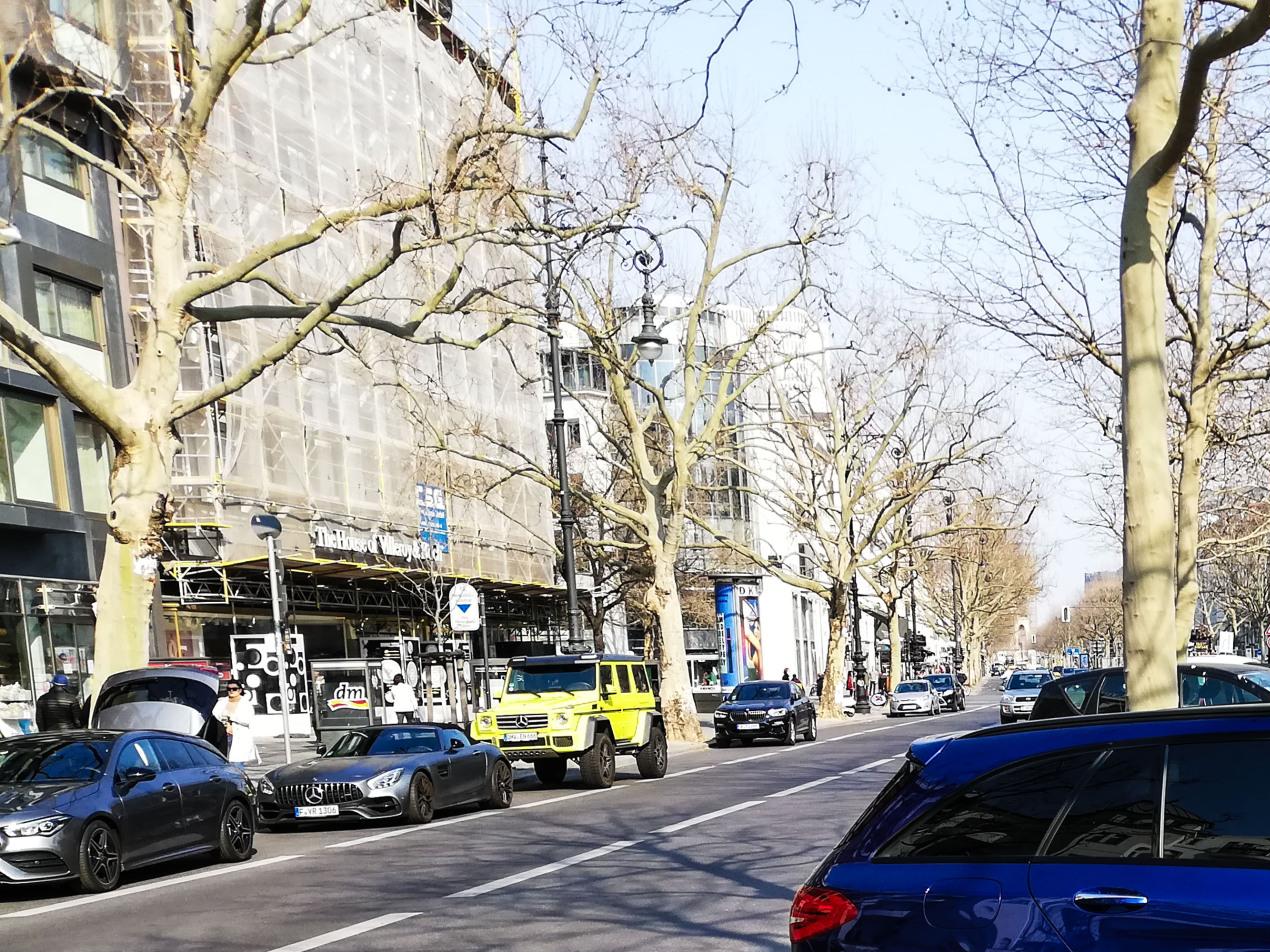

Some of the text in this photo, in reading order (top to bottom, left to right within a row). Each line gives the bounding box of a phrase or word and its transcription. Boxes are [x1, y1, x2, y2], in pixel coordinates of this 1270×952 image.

[314, 525, 337, 549] The
[337, 529, 367, 553] House
[378, 534, 412, 562] Villeroy
[337, 684, 363, 699] dm
